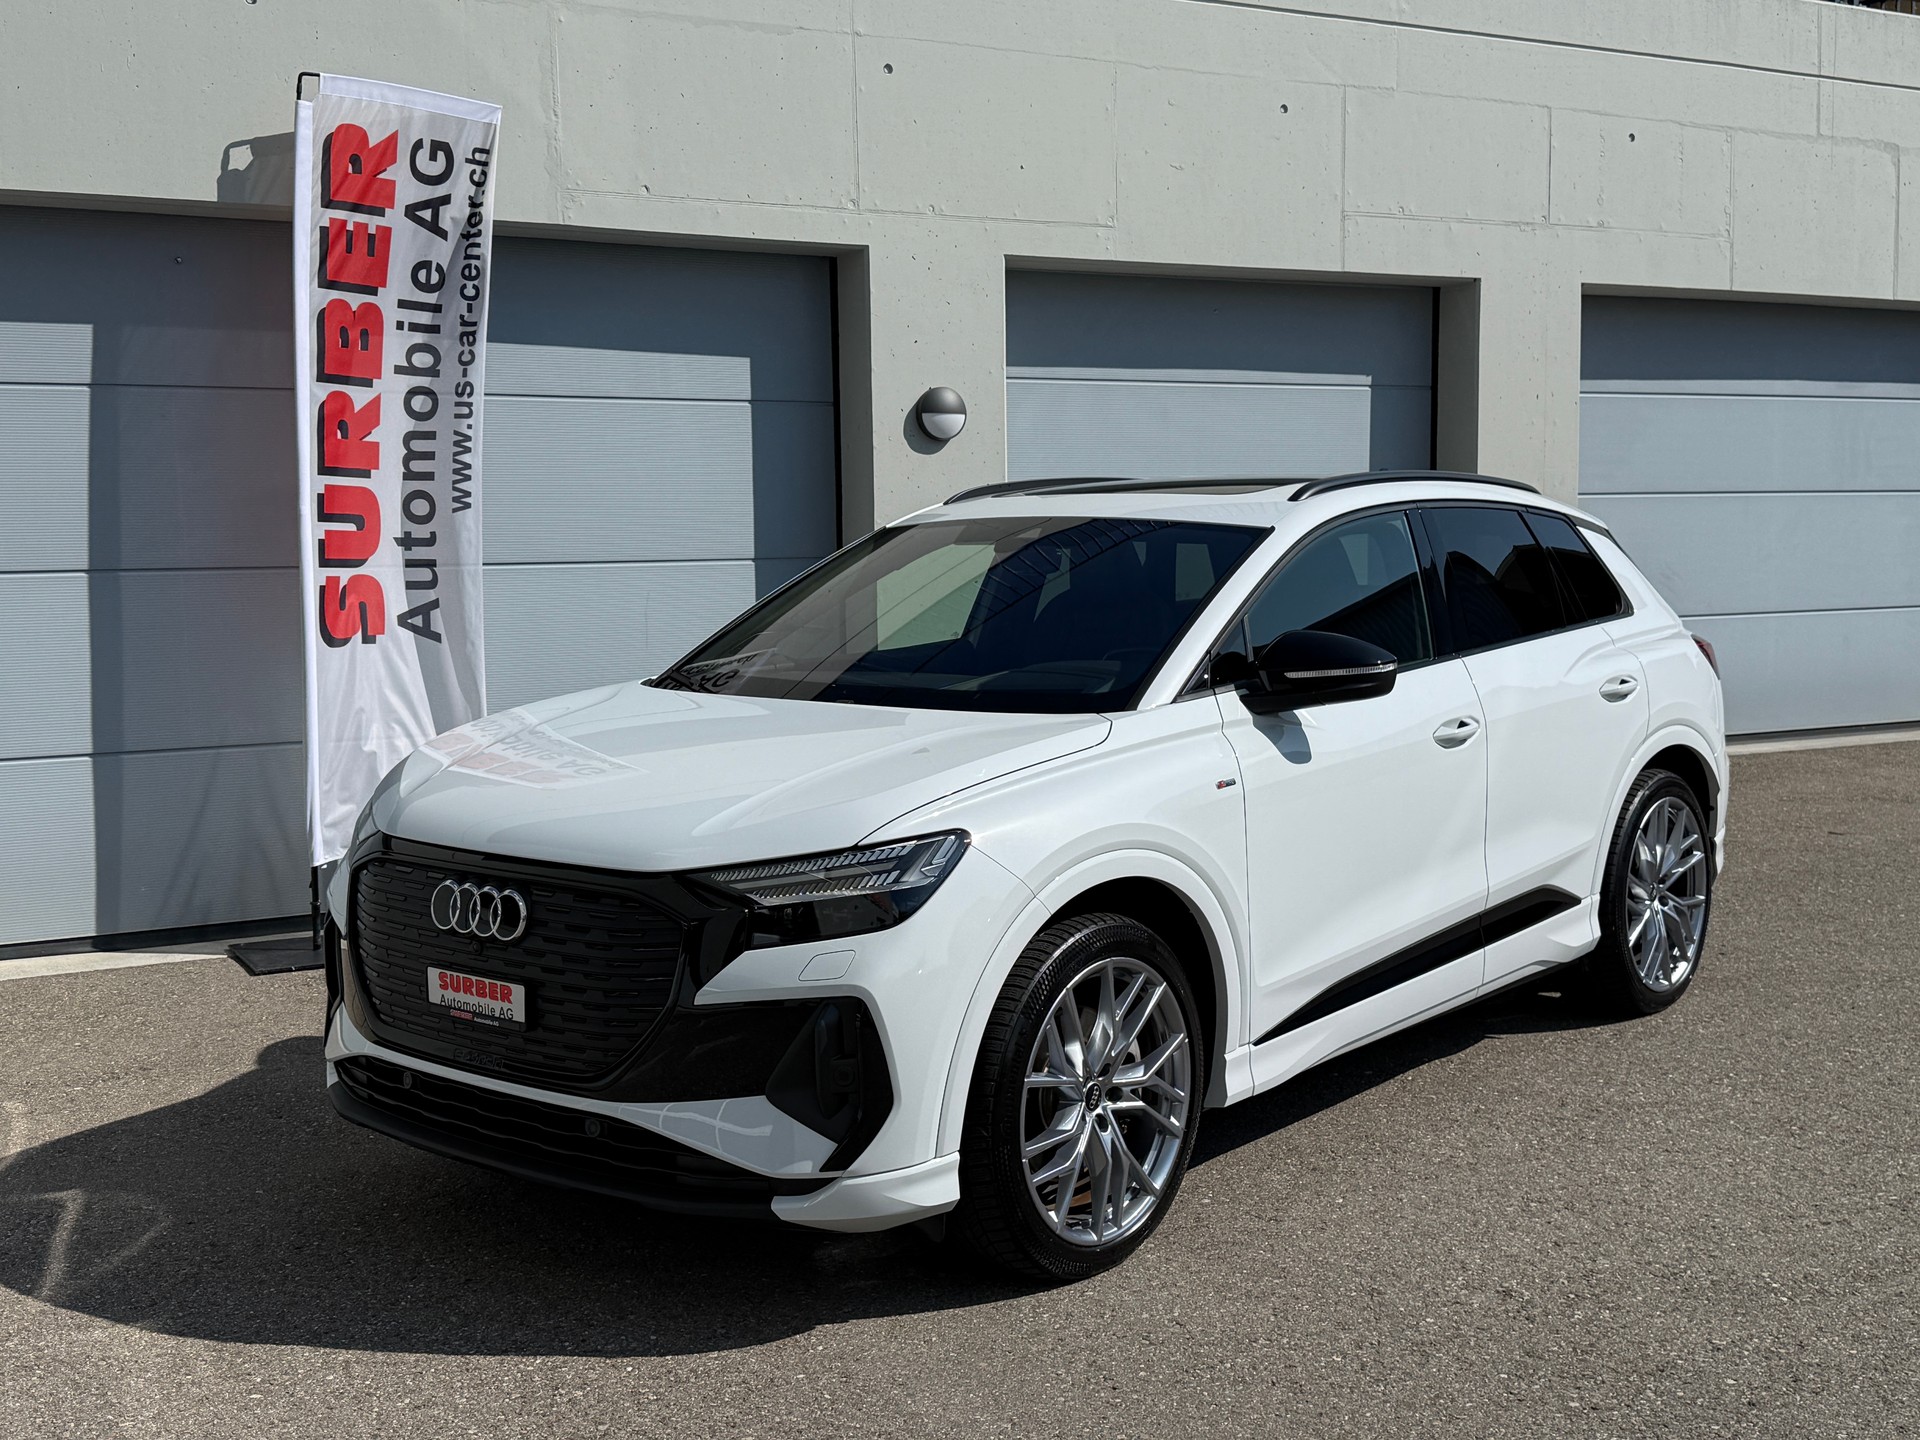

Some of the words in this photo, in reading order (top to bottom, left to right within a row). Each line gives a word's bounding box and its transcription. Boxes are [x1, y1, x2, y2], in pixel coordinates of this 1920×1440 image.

[403, 136, 456, 242] AG
[317, 123, 399, 648] SURBER
[451, 146, 491, 514] www.us-car-center.ch
[393, 260, 448, 645] Automobile
[438, 971, 513, 1005] SURBER
[439, 994, 496, 1017] Automobile
[498, 1007, 514, 1021] AG
